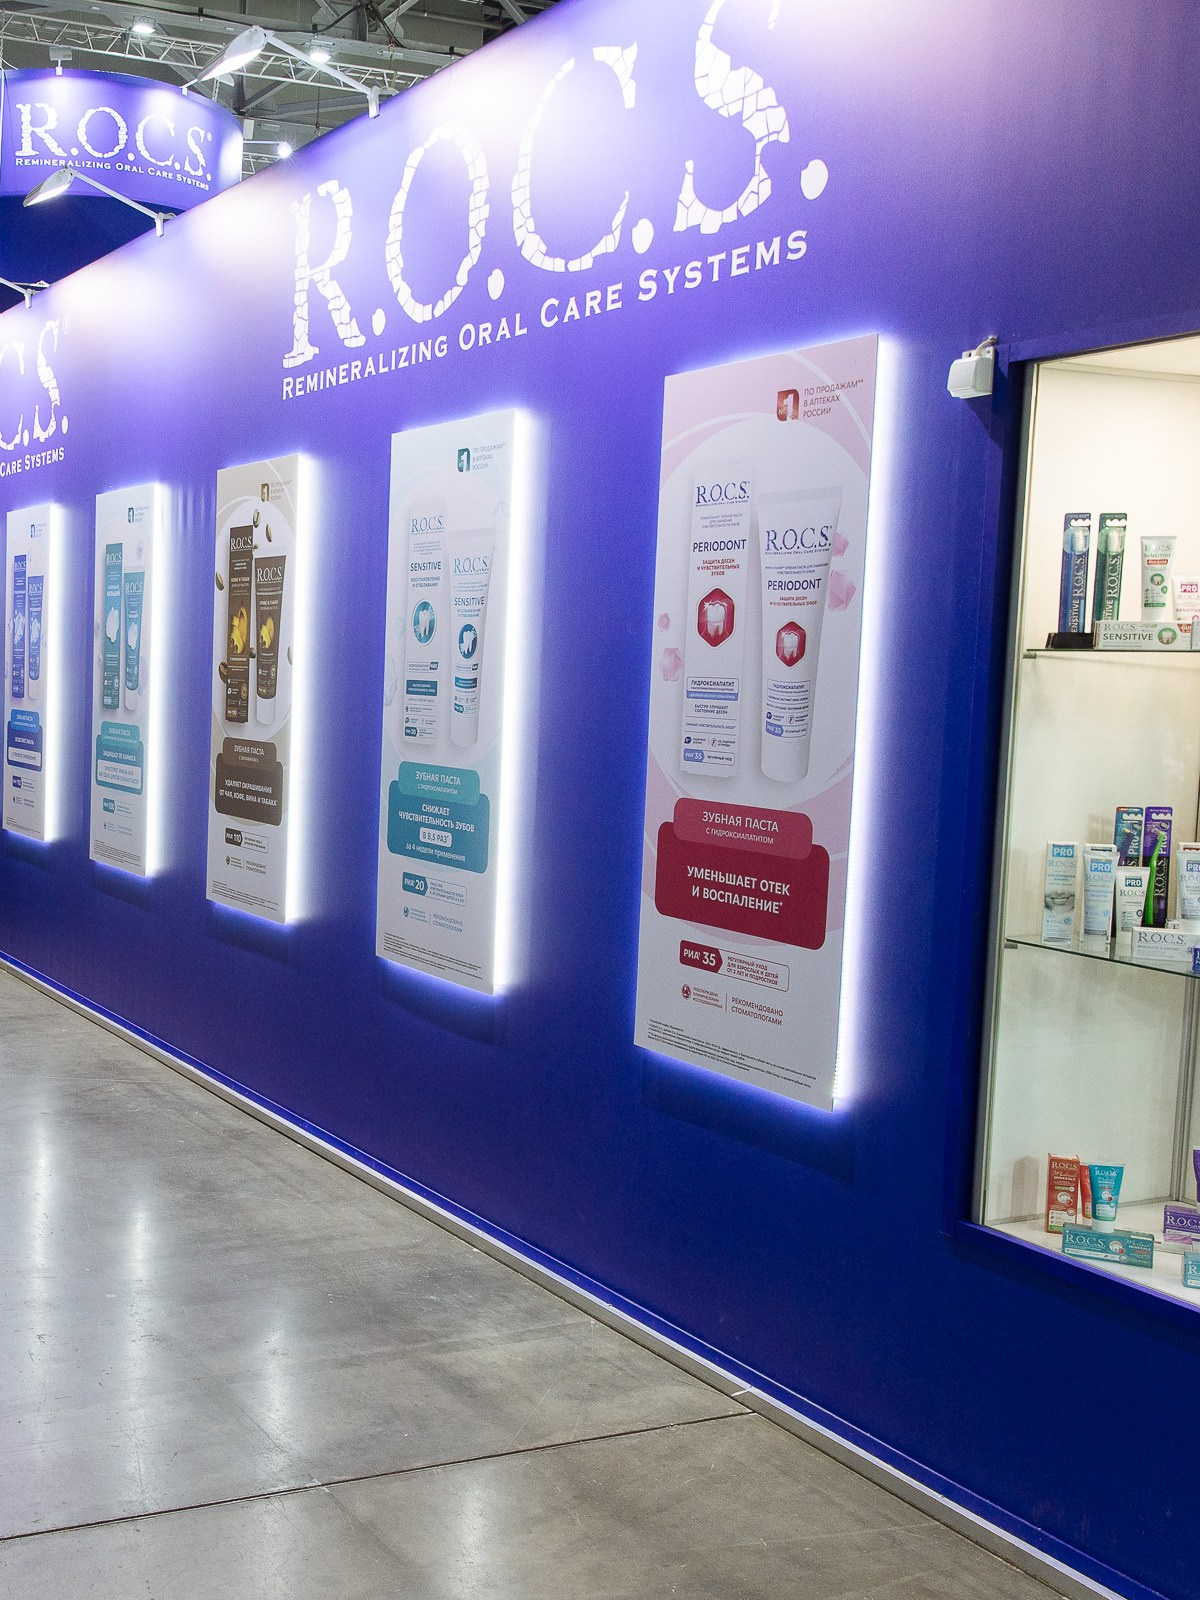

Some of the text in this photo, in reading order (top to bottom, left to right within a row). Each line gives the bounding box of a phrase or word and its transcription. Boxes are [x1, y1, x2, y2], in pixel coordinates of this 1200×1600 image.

[15, 158, 210, 191] REMINERALIZING ORAL CARE SYSTEMS
[283, 0, 829, 369] R.O.C.S.
[282, 230, 808, 400] REMINERALIZING ORAL CARE SYSTEMS
[804, 387, 815, 396] ПО
[810, 395, 840, 406] АПТЕКАХ
[803, 407, 832, 418] РОССИИ
[0, 458, 22, 477] CARE
[25, 447, 65, 471] SYSTEMS
[693, 539, 747, 552] PERIODONT
[410, 561, 442, 572] SENSITIVE
[1073, 555, 1087, 599] R.O.C.S.
[1106, 555, 1120, 600] R.O.C.S.
[767, 579, 822, 591] PERIODONT
[1181, 584, 1198, 592] PRO
[454, 596, 485, 607] SENSITIVE
[1071, 599, 1080, 633] ENSITIVE
[1103, 633, 1154, 641] SENSITIVE
[250, 747, 265, 755] ПАСТА
[415, 771, 461, 786] ЗУБНАЯ ПАСТА
[422, 804, 451, 816] СНИЖАЕТ
[398, 810, 475, 833] ЧУВСТВИТЕЛЬНОСТЬ ЗУБОВ
[702, 811, 779, 832] ЗУБНАЯ ПАСТА
[711, 828, 774, 844] ГИДРОКСИАПАТИТОМ
[1053, 847, 1073, 857] PRO
[1091, 863, 1112, 872] PRO
[415, 879, 425, 891] 20
[687, 866, 790, 896] УМЕНЬШАЕТ ОТЕК
[1125, 878, 1142, 887] PRO
[692, 886, 700, 897] И
[702, 951, 716, 966] 35
[756, 963, 768, 971] УХОД
[731, 996, 784, 1017] РЕКОМЕНДОВАНО
[731, 1006, 782, 1026] СТОМАТОЛОГАМИ
